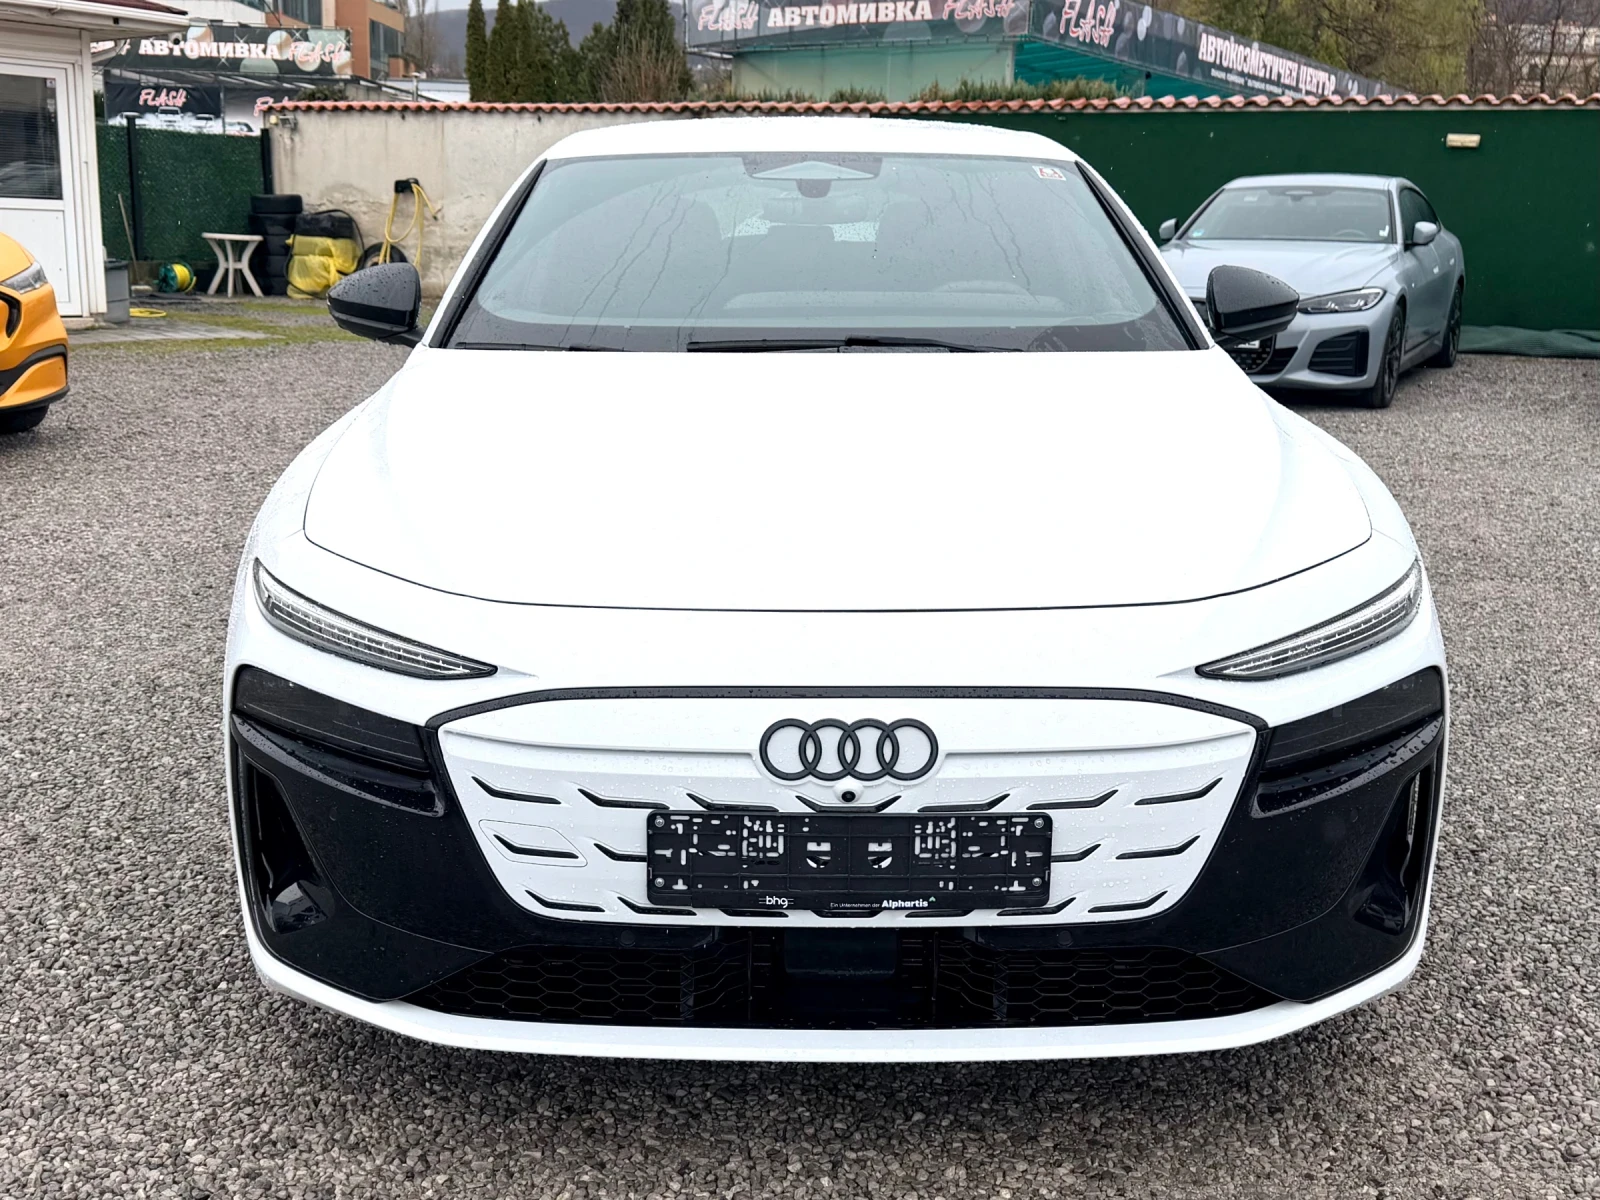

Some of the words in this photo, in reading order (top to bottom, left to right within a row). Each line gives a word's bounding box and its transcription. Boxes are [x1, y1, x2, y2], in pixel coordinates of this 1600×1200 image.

[766, 0, 933, 28] АВТОМИВКА
[1060, 0, 1116, 48] FLASH
[138, 39, 280, 59] АВТОМИВКА
[1198, 32, 1299, 87] АВТОКОЗМЕТИЧЕН
[138, 88, 187, 108] FLASH
[765, 895, 789, 909] bhg
[881, 898, 929, 909] Alphartis
